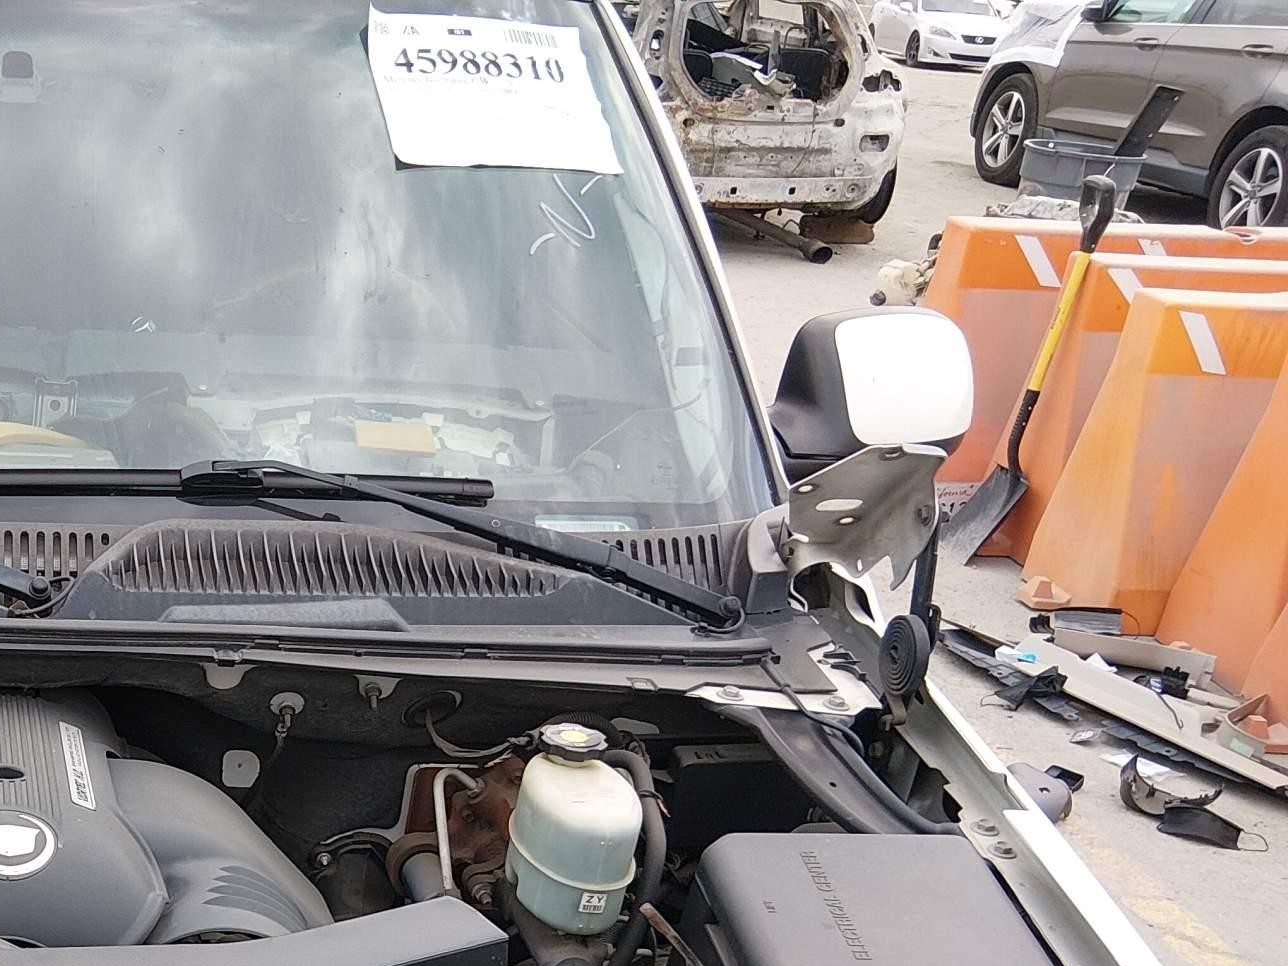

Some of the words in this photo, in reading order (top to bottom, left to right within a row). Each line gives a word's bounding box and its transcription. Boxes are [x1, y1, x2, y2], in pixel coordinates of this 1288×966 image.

[394, 48, 564, 83] 45988310
[799, 849, 835, 893] CENTER
[823, 895, 873, 961] ELECTRICAL
